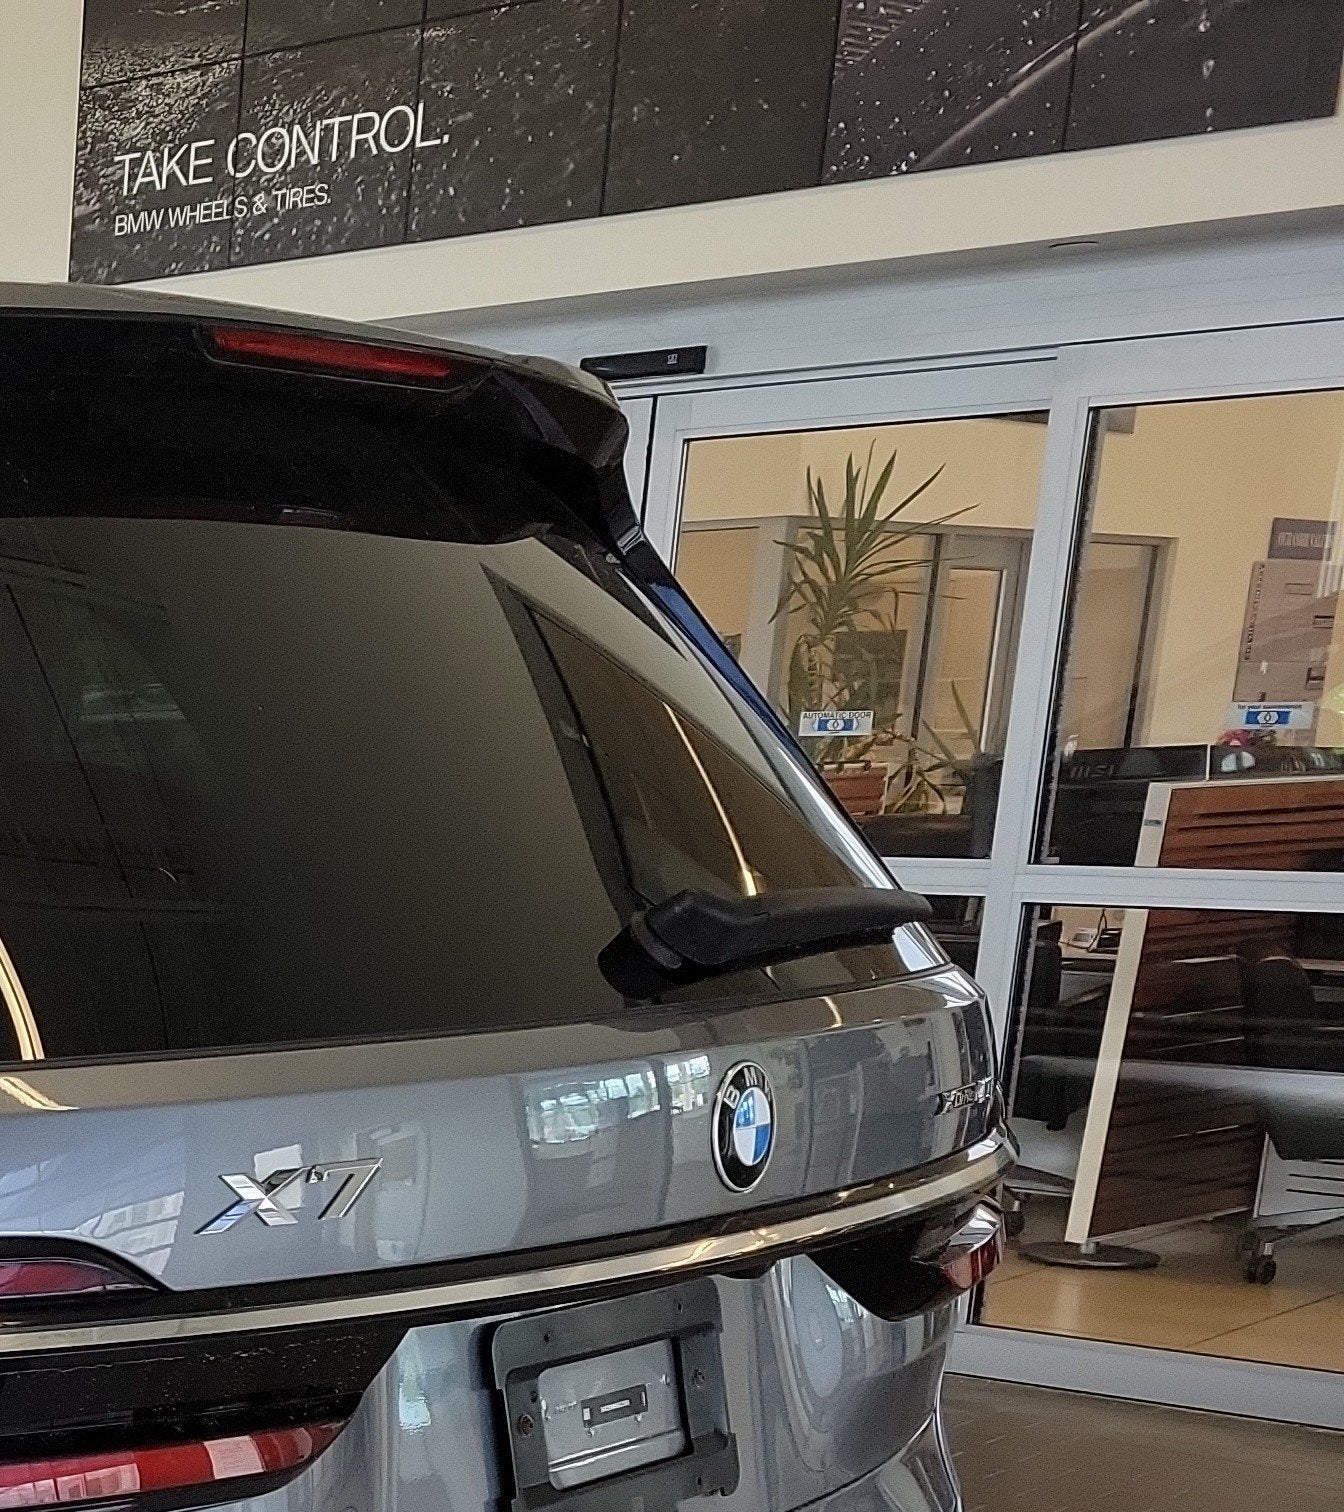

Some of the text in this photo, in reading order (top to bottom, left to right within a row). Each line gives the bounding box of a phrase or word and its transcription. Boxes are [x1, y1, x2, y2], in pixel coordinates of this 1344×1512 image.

[114, 101, 450, 197] TAKE CONTROL.
[114, 183, 332, 236] BMW WHEELS & TIRES.
[849, 711, 872, 719] DOOR
[194, 1157, 383, 1235] X7
